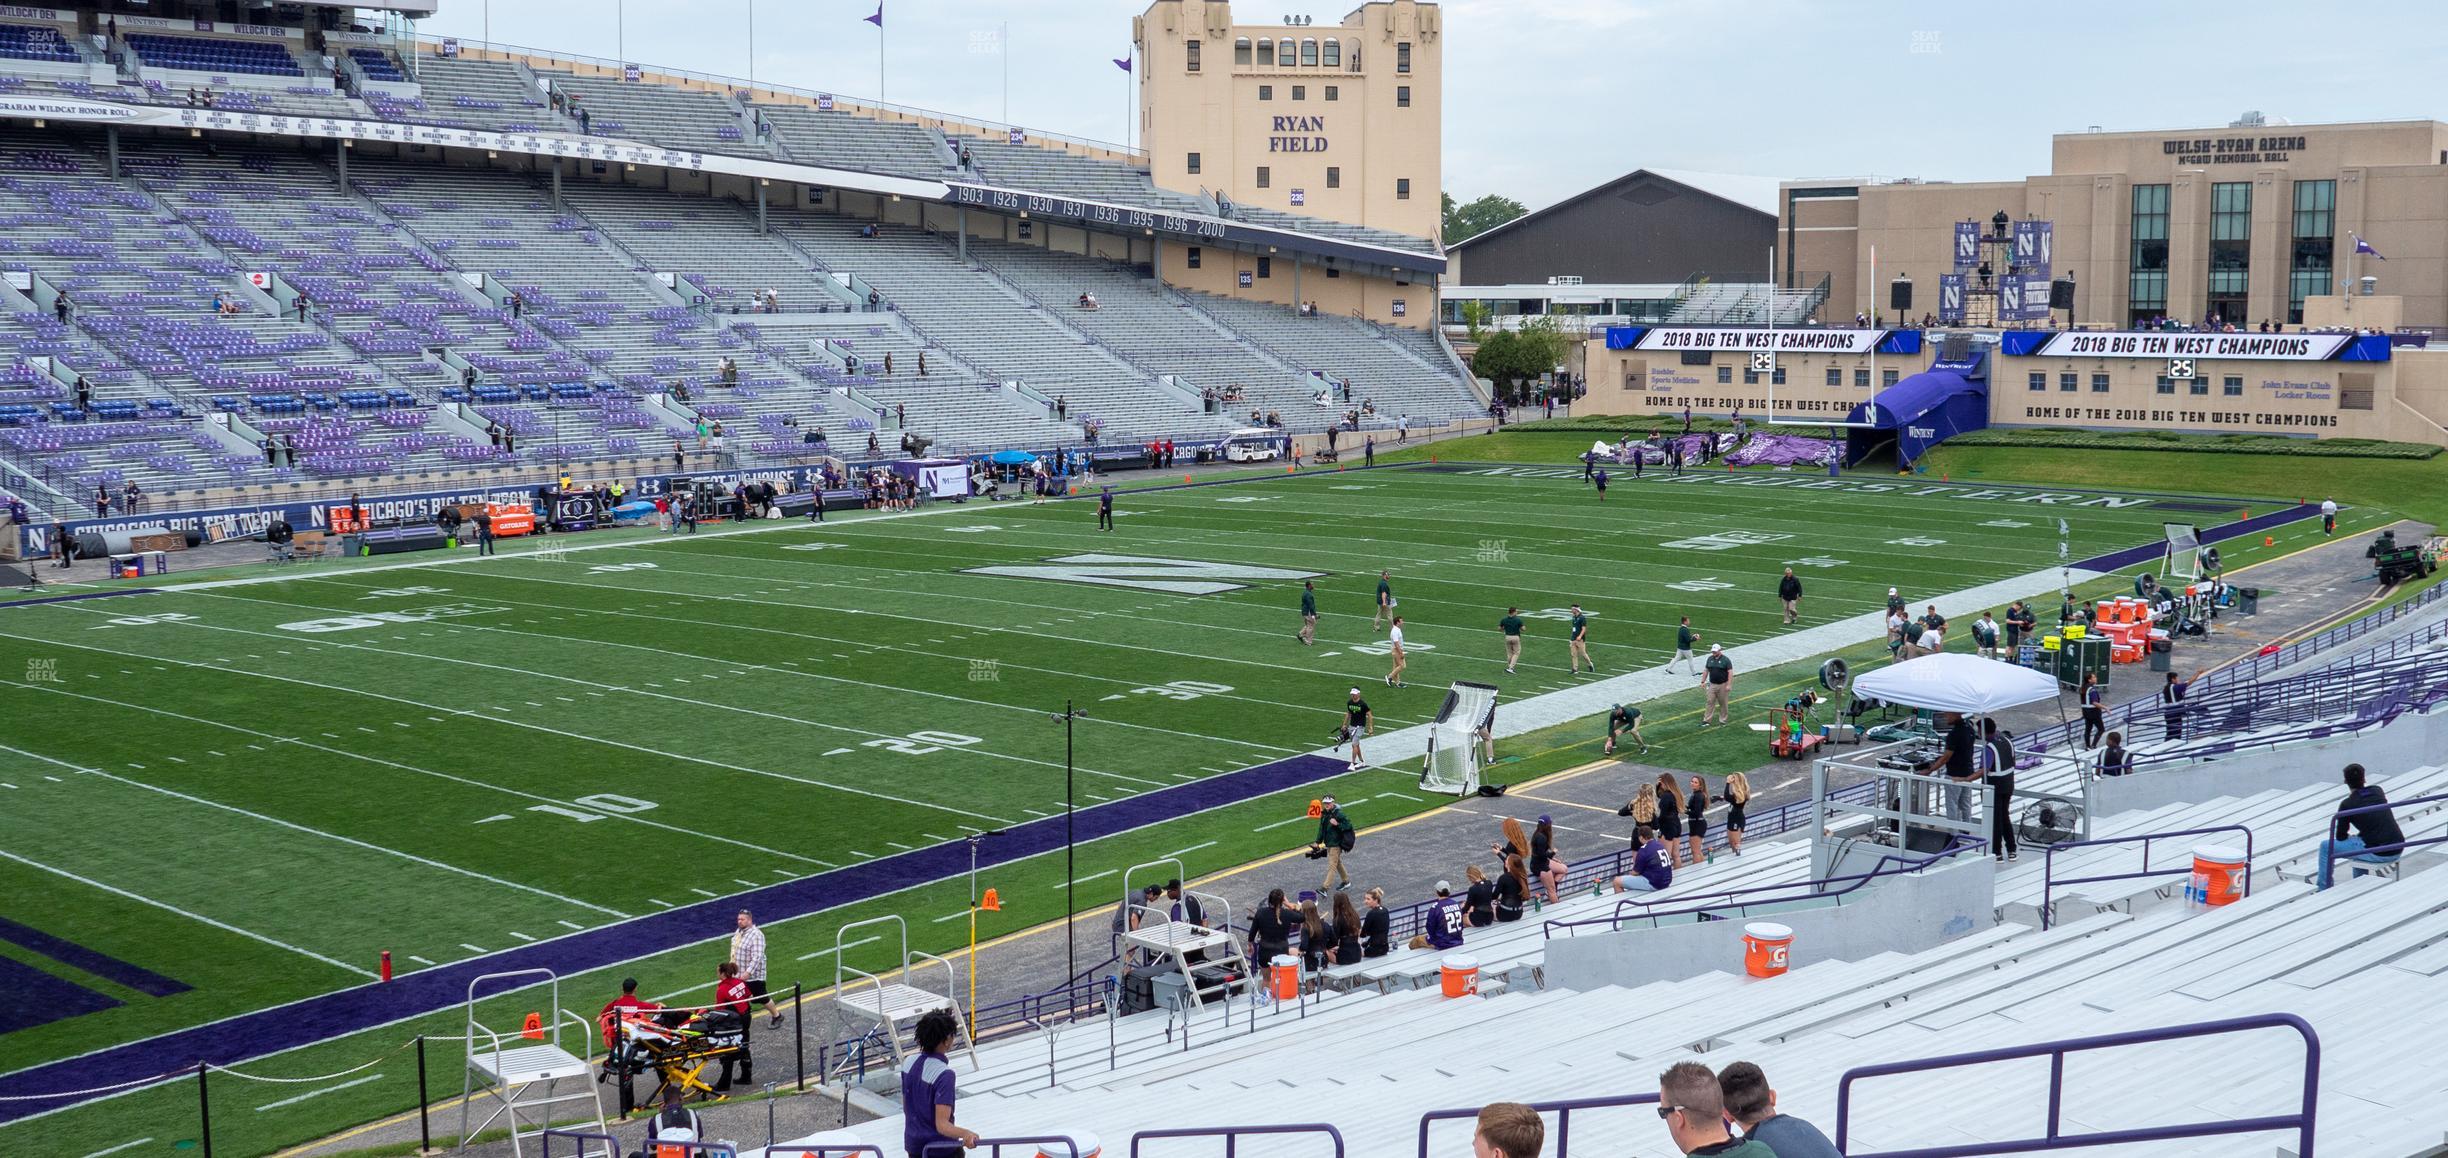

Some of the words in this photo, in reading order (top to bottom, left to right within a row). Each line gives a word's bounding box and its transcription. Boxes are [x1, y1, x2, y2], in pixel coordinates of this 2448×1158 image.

[40, 8, 57, 20] DEN
[233, 24, 270, 36] WILDCAT
[271, 26, 286, 37] DEN
[445, 44, 457, 53] 231
[626, 69, 639, 78] 232
[38, 105, 77, 114] WILDCAT
[79, 107, 107, 115] HONOR
[110, 109, 131, 117] ROLL
[819, 99, 832, 108] 233
[1272, 115, 1325, 132] RYAN
[1010, 133, 1023, 141] 234
[1269, 136, 1329, 153] FIELD
[2163, 138, 2254, 154] WELSH-RYAN
[2258, 136, 2306, 151] ARENA
[2213, 153, 2262, 164] MEMORIAL
[2264, 152, 2289, 162] HALL
[1291, 192, 1304, 201] 235
[957, 187, 983, 203] 1903
[992, 191, 1018, 207] 1926
[1028, 196, 1053, 213] 1930
[1062, 200, 1086, 217] 1931
[1094, 205, 1119, 222] 1936
[1129, 210, 1153, 227] 1995
[1163, 215, 1188, 233] 1996
[1197, 221, 1225, 238] 2000
[1959, 233, 1975, 257] N
[2018, 233, 2034, 256] N
[1240, 275, 1251, 283] 135
[1945, 286, 1960, 309] N
[2003, 286, 2019, 310] N
[1393, 304, 1405, 312] 136
[1662, 332, 1691, 347] 2018
[1694, 332, 1716, 347] BIG
[1719, 333, 1742, 347] TEN
[1745, 333, 1778, 348] WEST
[1781, 333, 1855, 349] CHAMPIONS
[2071, 336, 2106, 352] 2018
[2111, 336, 2137, 353] BIG
[2142, 337, 2169, 354] TEN
[2173, 337, 2214, 354] WEST
[2218, 338, 2310, 356] CHAMPIONS
[2171, 359, 2192, 377] 25
[1651, 376, 1672, 385] Sports
[1672, 376, 1700, 384] Medicine
[2261, 380, 2282, 390] John
[2283, 381, 2309, 390] Evans
[2310, 381, 2331, 390] Club
[1645, 396, 1673, 406] HOME
[1677, 397, 1691, 407] OF
[1694, 397, 1714, 407] THE
[1718, 398, 1744, 409] 2018
[1748, 399, 1766, 409] BIG
[1772, 399, 1793, 410] TEN
[1797, 400, 1828, 411] WEST
[2275, 391, 2304, 400] Locker
[2305, 392, 2330, 400] Room
[2026, 406, 2061, 418] HOME
[2065, 407, 2081, 419] OF
[2086, 408, 2111, 420] THE
[2116, 409, 2147, 421] 2018
[2152, 410, 2174, 422] BIG
[2179, 411, 2206, 423] TEN
[2211, 412, 2251, 424] WEST
[2255, 413, 2338, 427] CHAMPIONS
[1276, 439, 1284, 454] N
[925, 469, 938, 494] N
[311, 505, 325, 527] N
[359, 500, 428, 521] HICAGO'S
[500, 521, 529, 530] GATORADE
[28, 527, 45, 551] N
[1130, 680, 1236, 702] 30
[862, 729, 984, 756] 20
[526, 791, 660, 824] 10
[1310, 804, 1321, 816] 20
[1656, 848, 1672, 868] 51
[987, 897, 996, 906] 10
[1442, 903, 1460, 914] BROWN
[1445, 910, 1463, 934] 22
[1773, 946, 1787, 963] G
[528, 1019, 538, 1031] G
